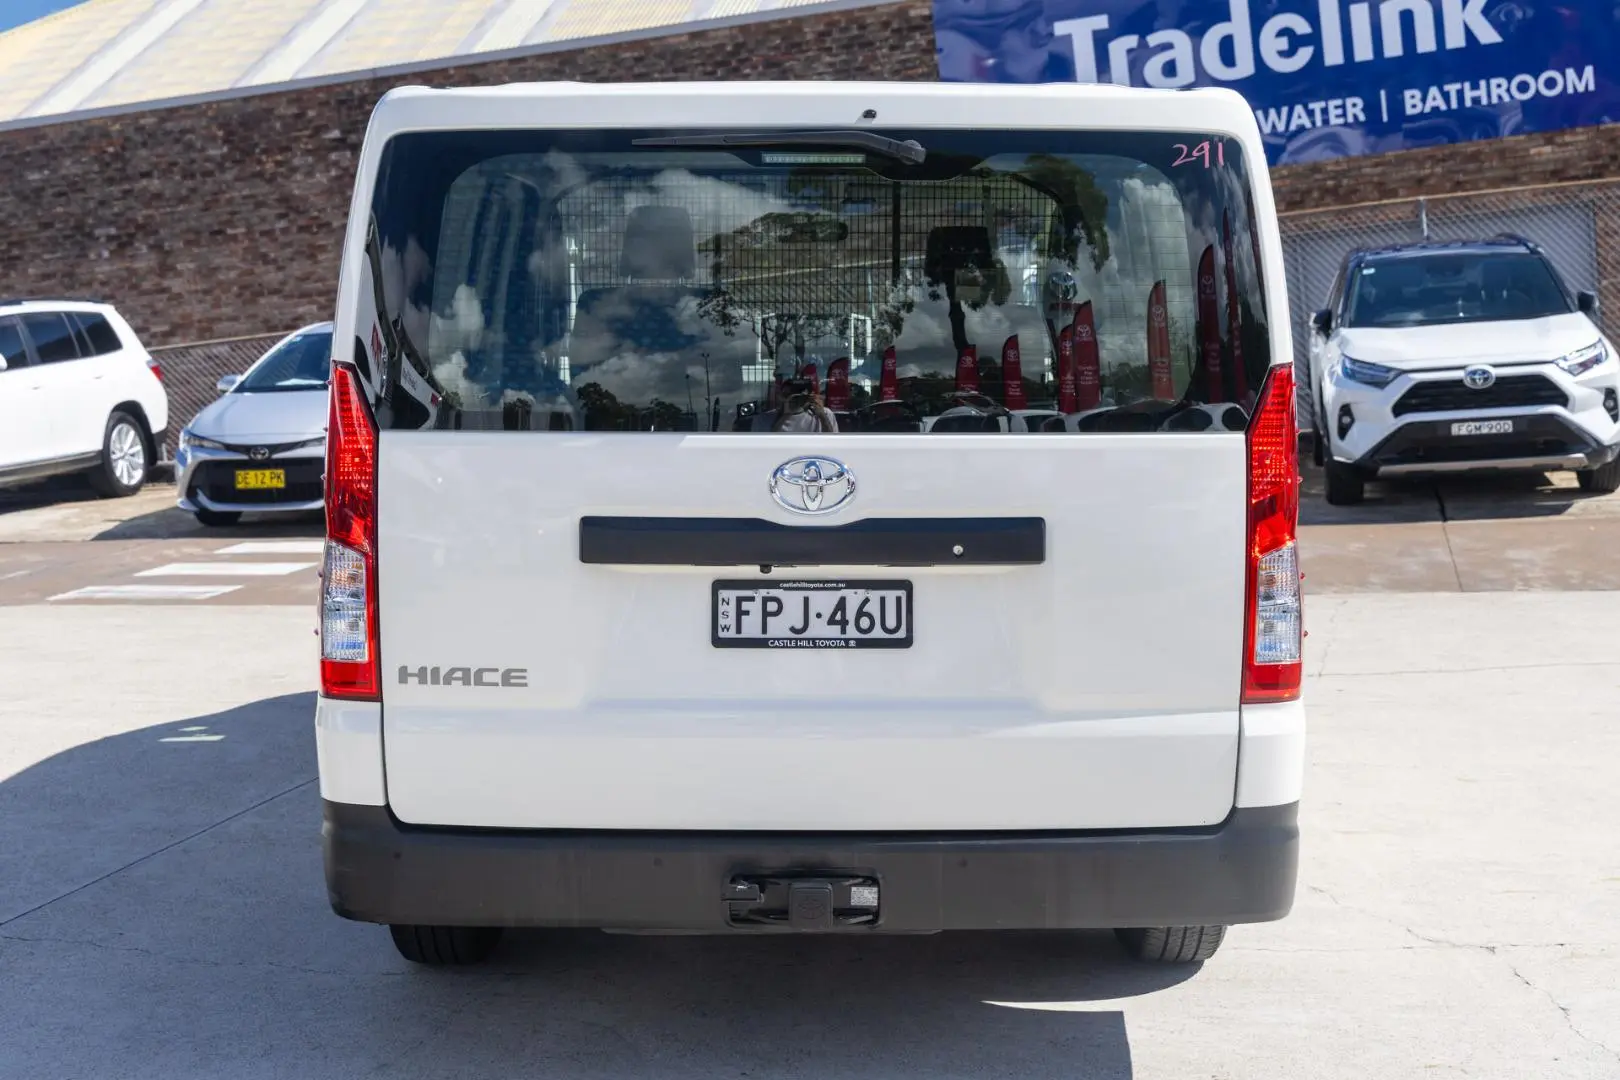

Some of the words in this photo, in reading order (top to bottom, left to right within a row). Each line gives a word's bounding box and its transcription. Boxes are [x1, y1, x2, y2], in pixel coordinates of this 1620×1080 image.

[1053, 0, 1503, 88] Tradelink
[1255, 96, 1366, 134] WATER
[1403, 65, 1595, 116] BATHROOM
[1171, 141, 1224, 168] 291
[236, 471, 250, 485] DE
[254, 471, 266, 485] 12
[768, 639, 796, 647] CASTLE
[797, 639, 814, 647] HILL
[815, 639, 845, 647] TOYOTA
[398, 665, 528, 687] HIACE
